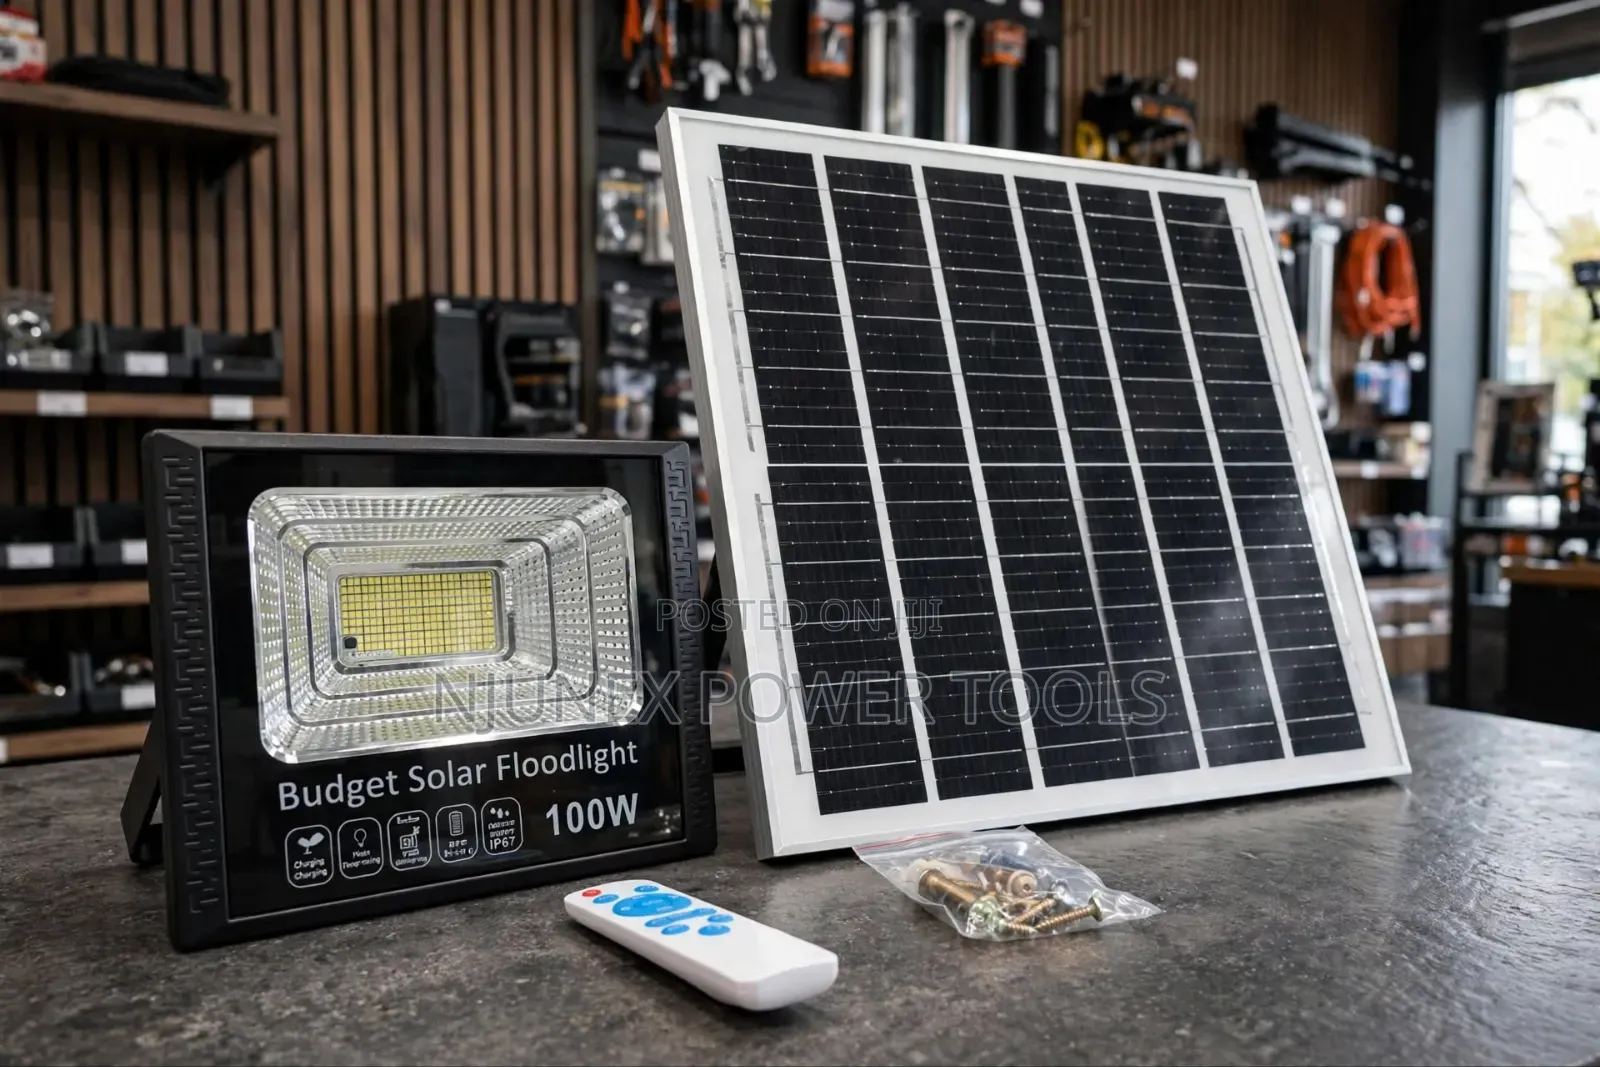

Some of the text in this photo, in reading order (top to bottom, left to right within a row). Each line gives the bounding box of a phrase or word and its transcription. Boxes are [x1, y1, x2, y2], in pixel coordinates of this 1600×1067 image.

[278, 740, 638, 811] Budget Solar Floodlight
[546, 792, 639, 836] 100W
[489, 835, 516, 851] IP67
